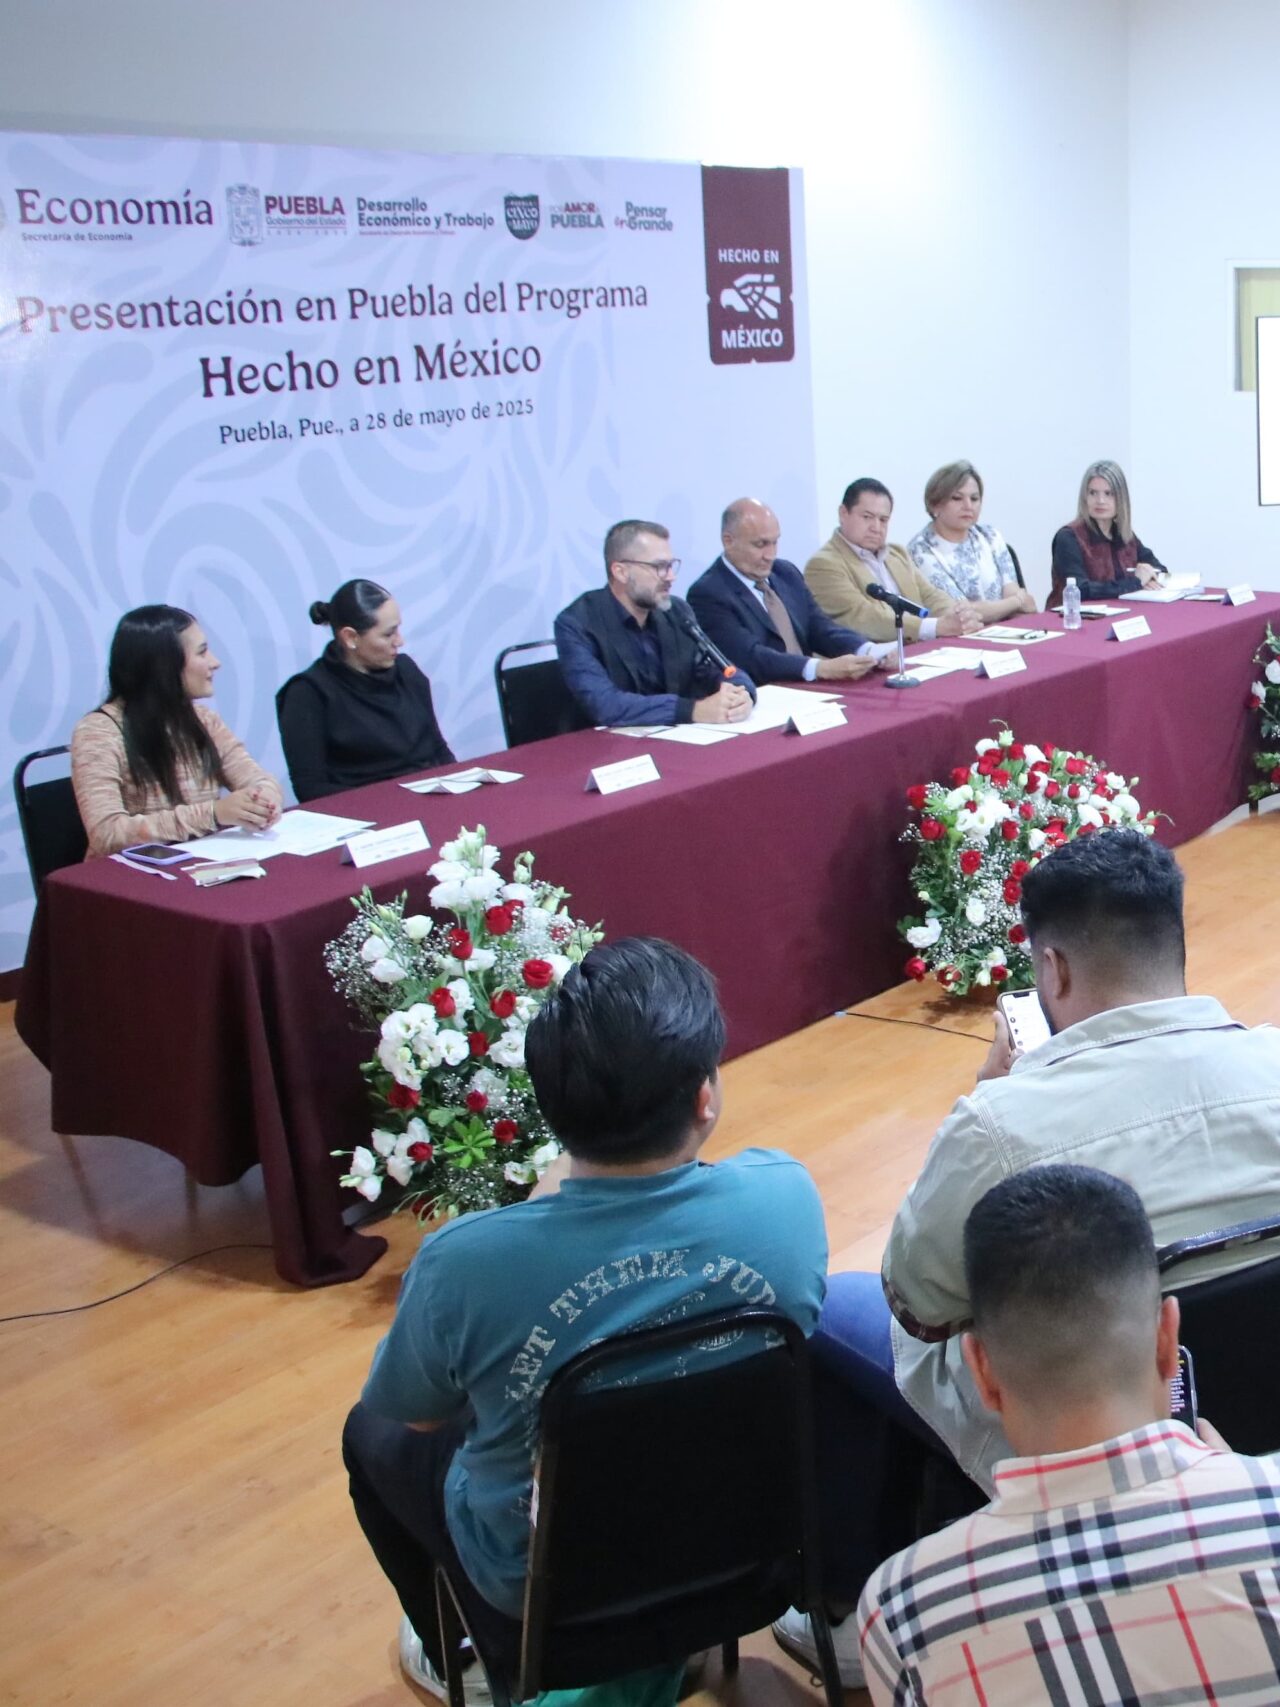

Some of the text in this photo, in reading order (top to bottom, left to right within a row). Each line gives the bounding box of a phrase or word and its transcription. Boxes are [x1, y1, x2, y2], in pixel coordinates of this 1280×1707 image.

[15, 188, 213, 225] Economía
[265, 196, 345, 215] PUEBLA
[357, 197, 427, 211] Desarrollo
[564, 202, 595, 213] AMOR
[625, 201, 667, 218] Pensar
[358, 213, 431, 227] Económico
[434, 216, 441, 229] y
[444, 212, 495, 230] Trabajo
[550, 214, 604, 228] PUEBLA
[627, 216, 673, 231] Grande
[74, 232, 85, 241] de
[718, 248, 779, 264] HECHO EN
[17, 281, 648, 334] Presentación en Puebla del Programa
[721, 324, 784, 349] MÉXICO
[199, 339, 542, 398] Hecho en México
[219, 399, 534, 444] Puebla, Pue., a 28 de mayo de 2025
[549, 1249, 690, 1325] THEM
